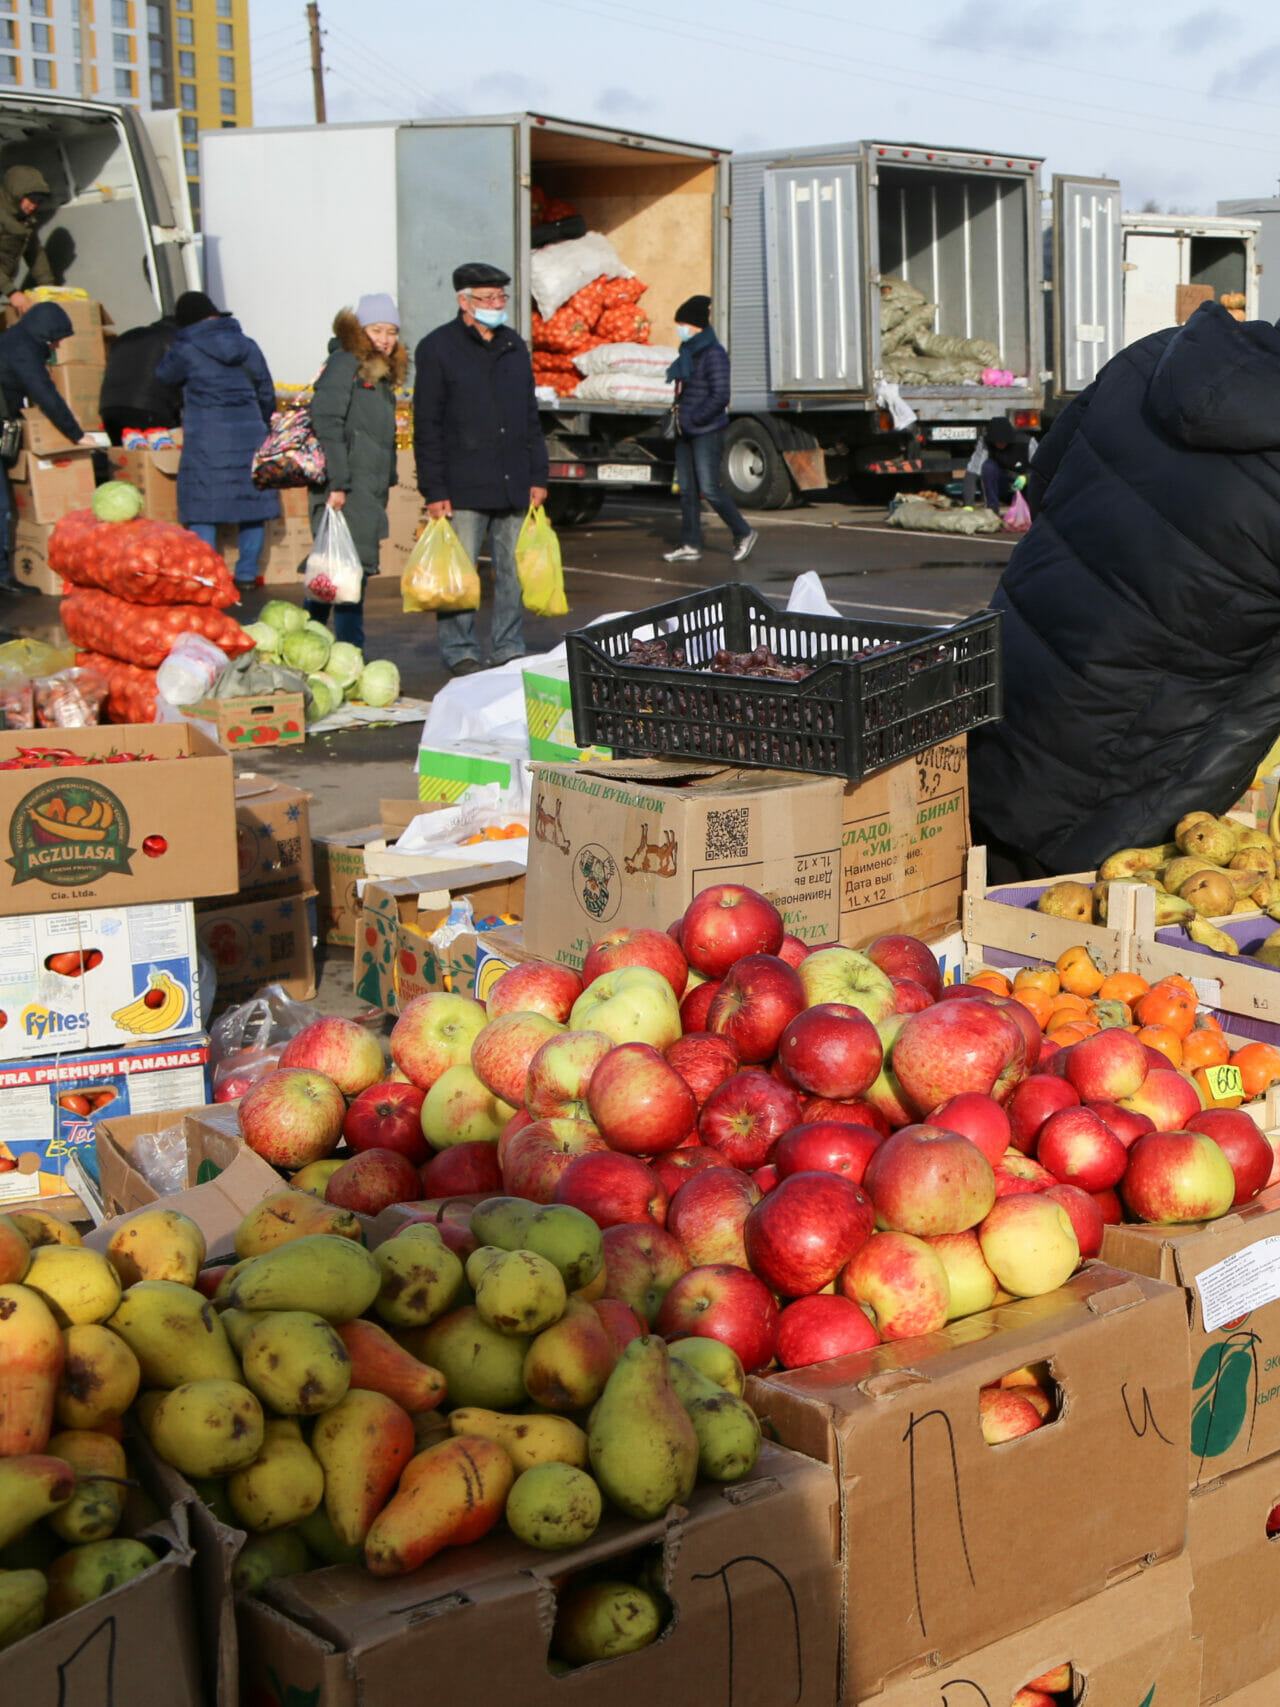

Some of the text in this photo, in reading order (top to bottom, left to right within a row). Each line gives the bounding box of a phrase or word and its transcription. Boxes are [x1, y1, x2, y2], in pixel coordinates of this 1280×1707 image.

[538, 768, 666, 814] МОЛОЧНАЯ ПРОДУКЦИЯ
[28, 846, 116, 868] AGZULASA
[809, 870, 833, 884] Дата
[51, 889, 97, 900] Cia. Ltda.
[845, 879, 872, 894] Дата
[874, 889, 887, 900] 12
[25, 1010, 90, 1039] fyffes
[35, 1061, 114, 1082] PREMIUM
